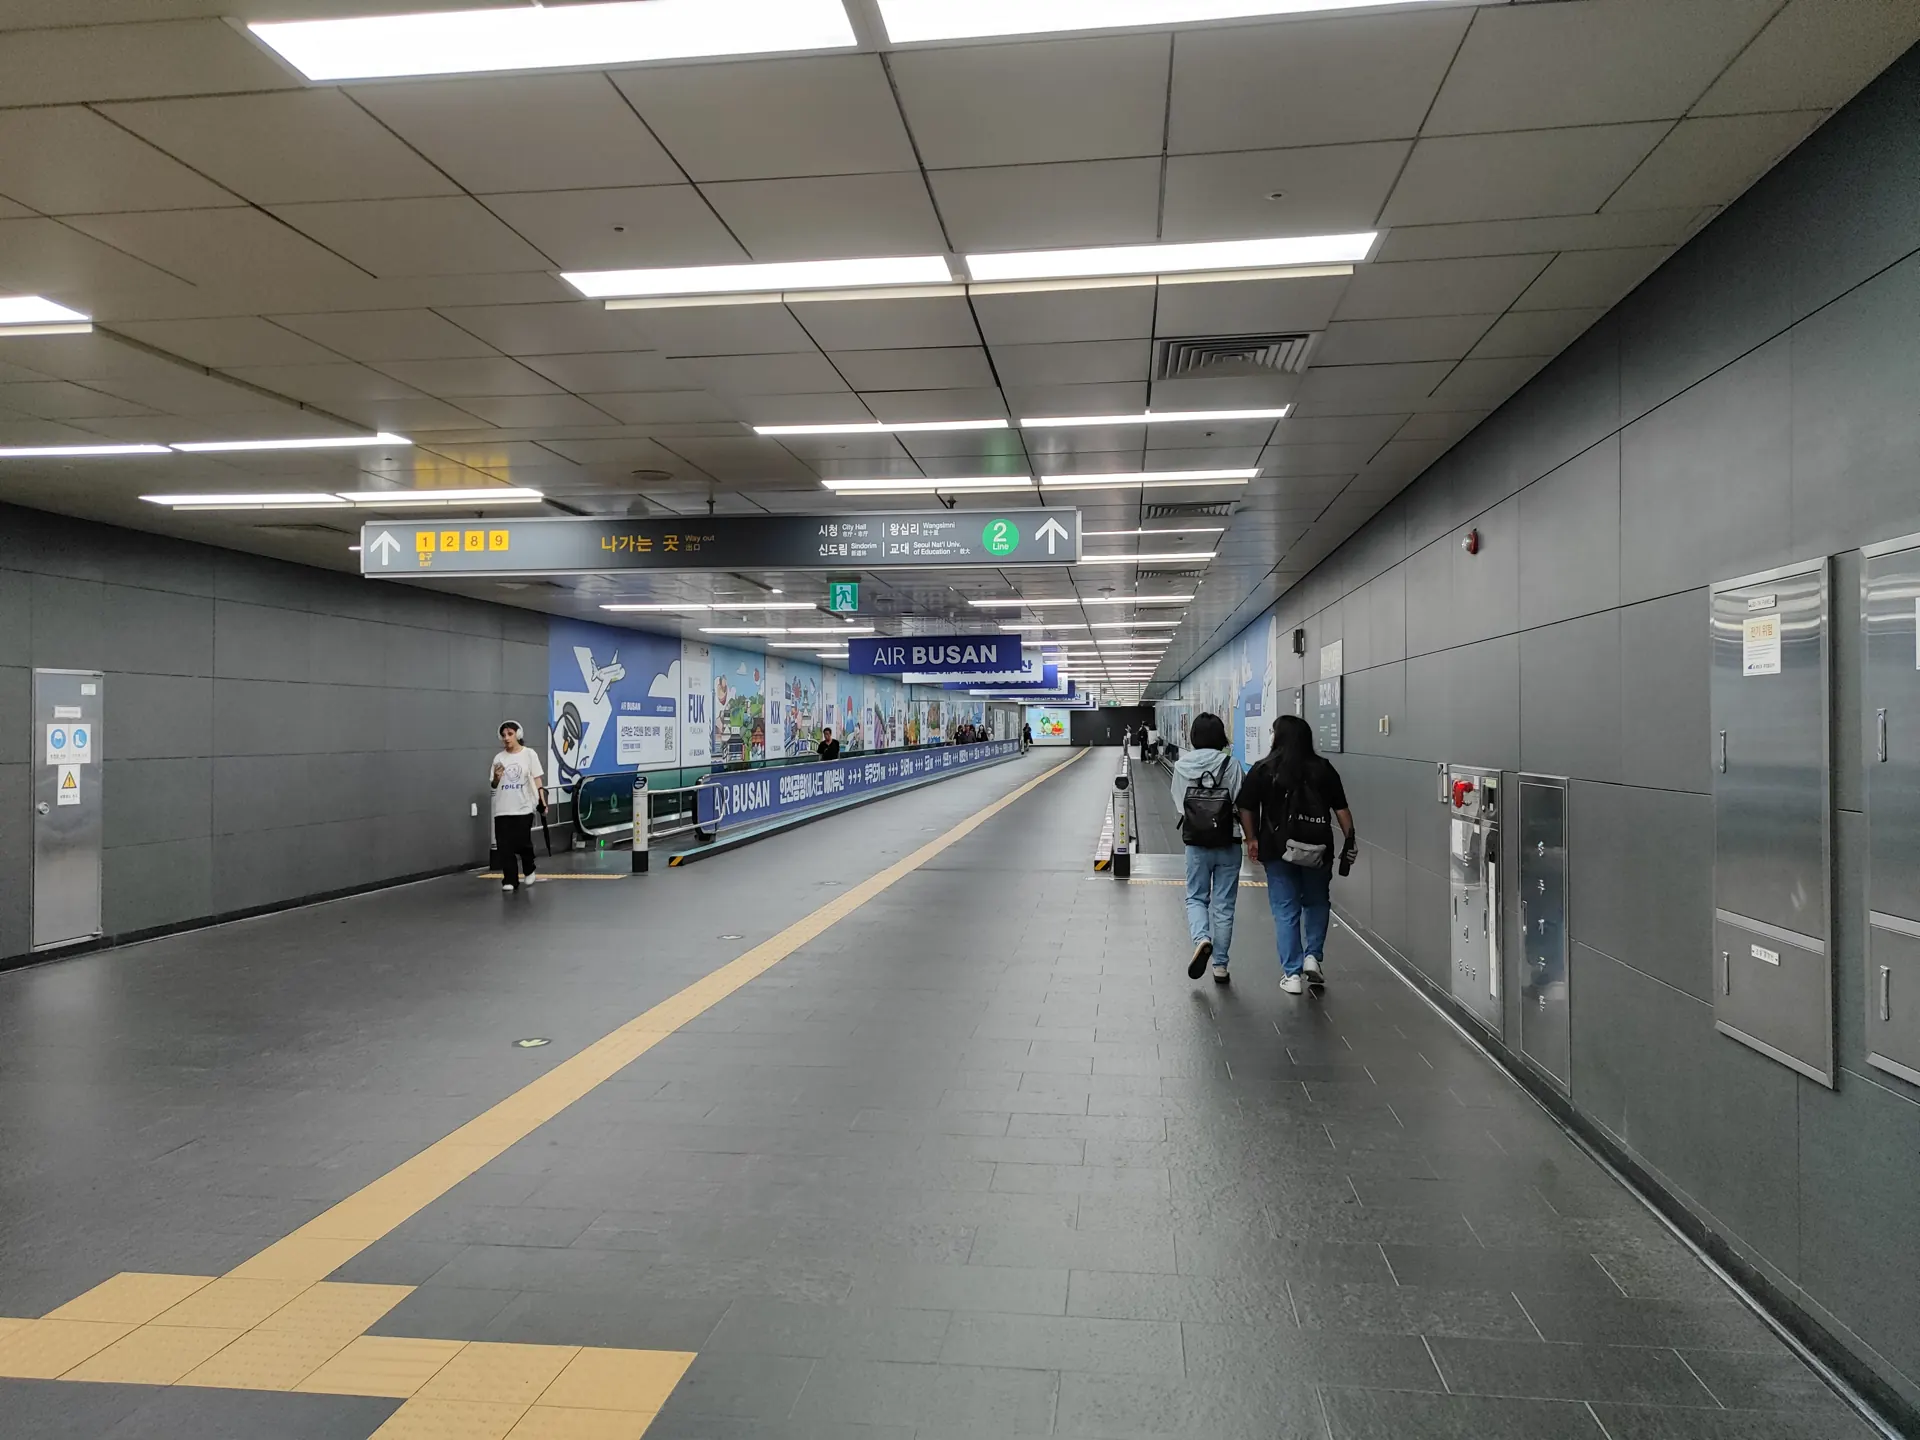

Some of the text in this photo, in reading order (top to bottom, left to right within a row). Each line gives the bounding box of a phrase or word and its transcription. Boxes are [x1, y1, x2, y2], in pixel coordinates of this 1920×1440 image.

[818, 524, 838, 537] 시청
[889, 523, 919, 536] 왕십리
[922, 521, 956, 529] Wangsimni
[684, 534, 701, 543] Way
[993, 522, 1007, 542] 2
[446, 536, 454, 547] 2
[470, 535, 478, 546] 8
[495, 535, 503, 546] 9
[601, 534, 680, 552] 나가는 곳
[851, 541, 877, 549] Sindorim
[992, 543, 1010, 551] Line
[818, 543, 848, 556] 신도림
[889, 542, 910, 555] 교대
[873, 644, 997, 666] AIR BUSAN
[688, 694, 705, 723] FUK
[770, 700, 781, 724] KIX
[732, 780, 770, 813] BUSAN
